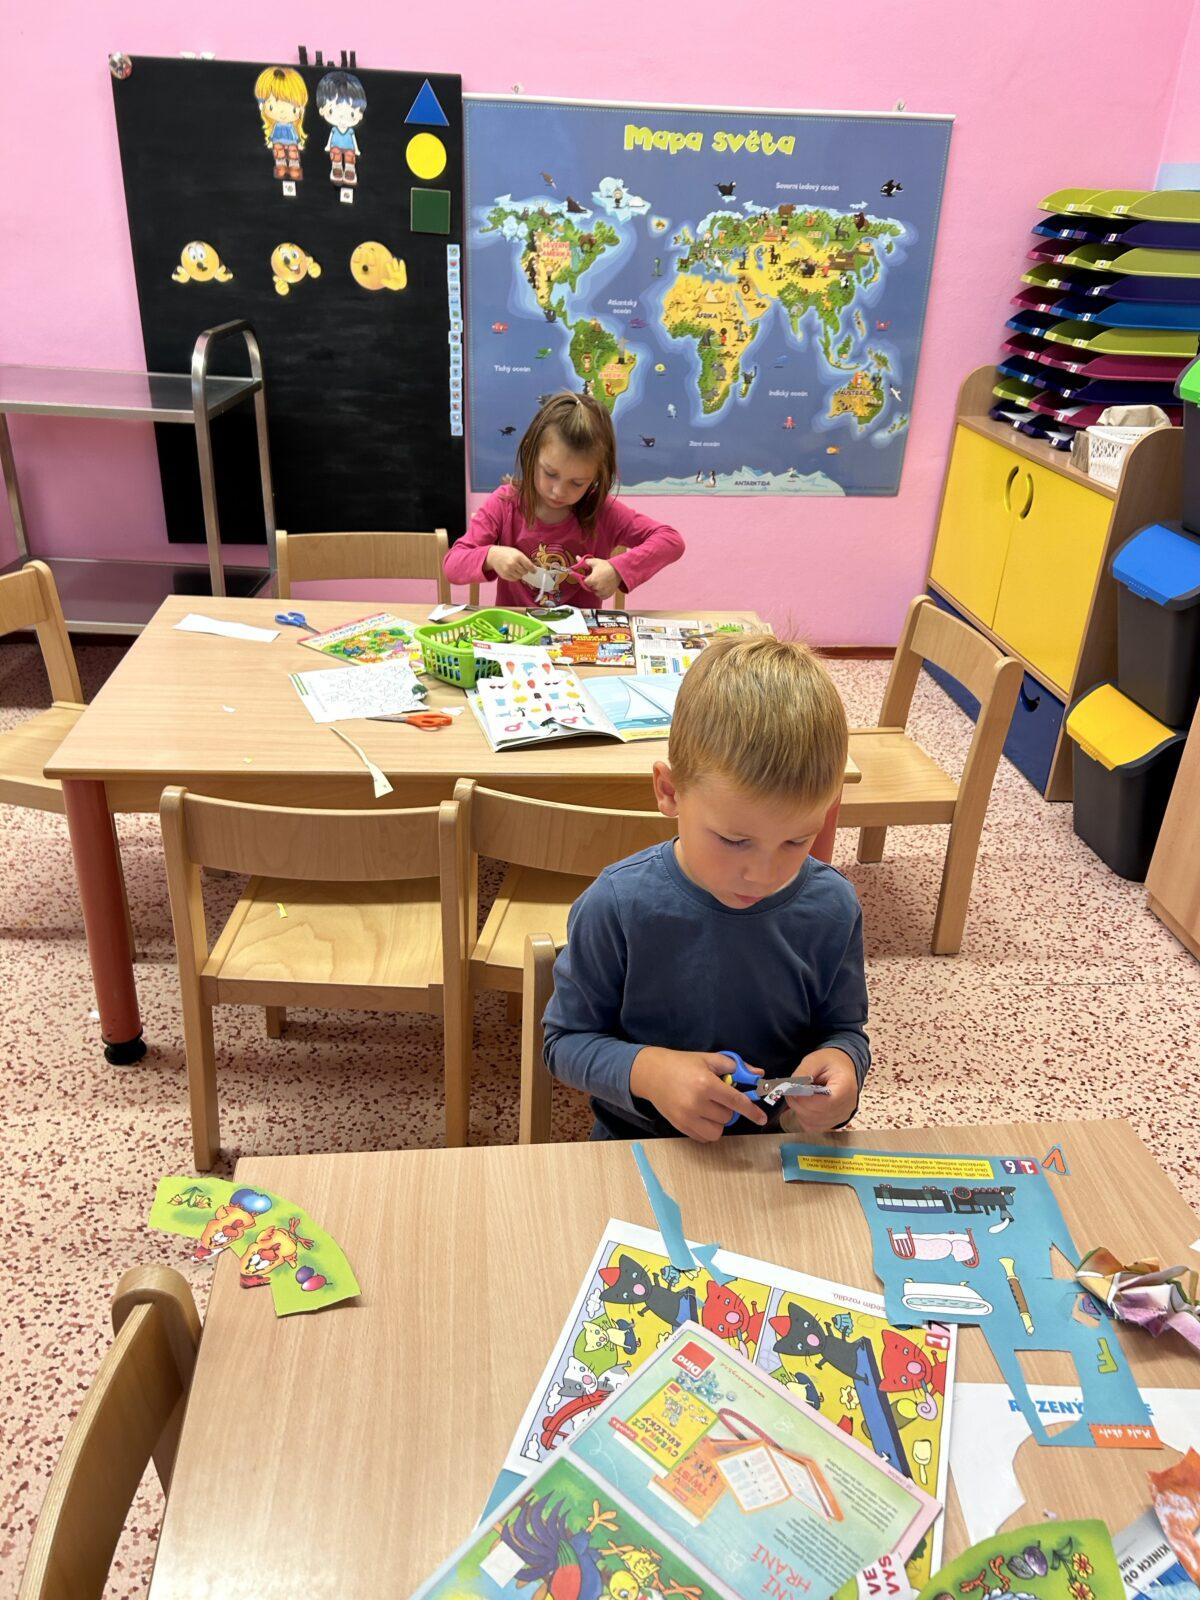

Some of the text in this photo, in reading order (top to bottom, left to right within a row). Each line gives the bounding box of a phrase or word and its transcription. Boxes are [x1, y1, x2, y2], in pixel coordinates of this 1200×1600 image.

[624, 124, 796, 156] Mapa světa
[695, 312, 719, 320] AFRIKA
[676, 1355, 702, 1376] Dino
[1008, 1398, 1084, 1414] RZENÝ
[1136, 1542, 1171, 1573] KINECH
